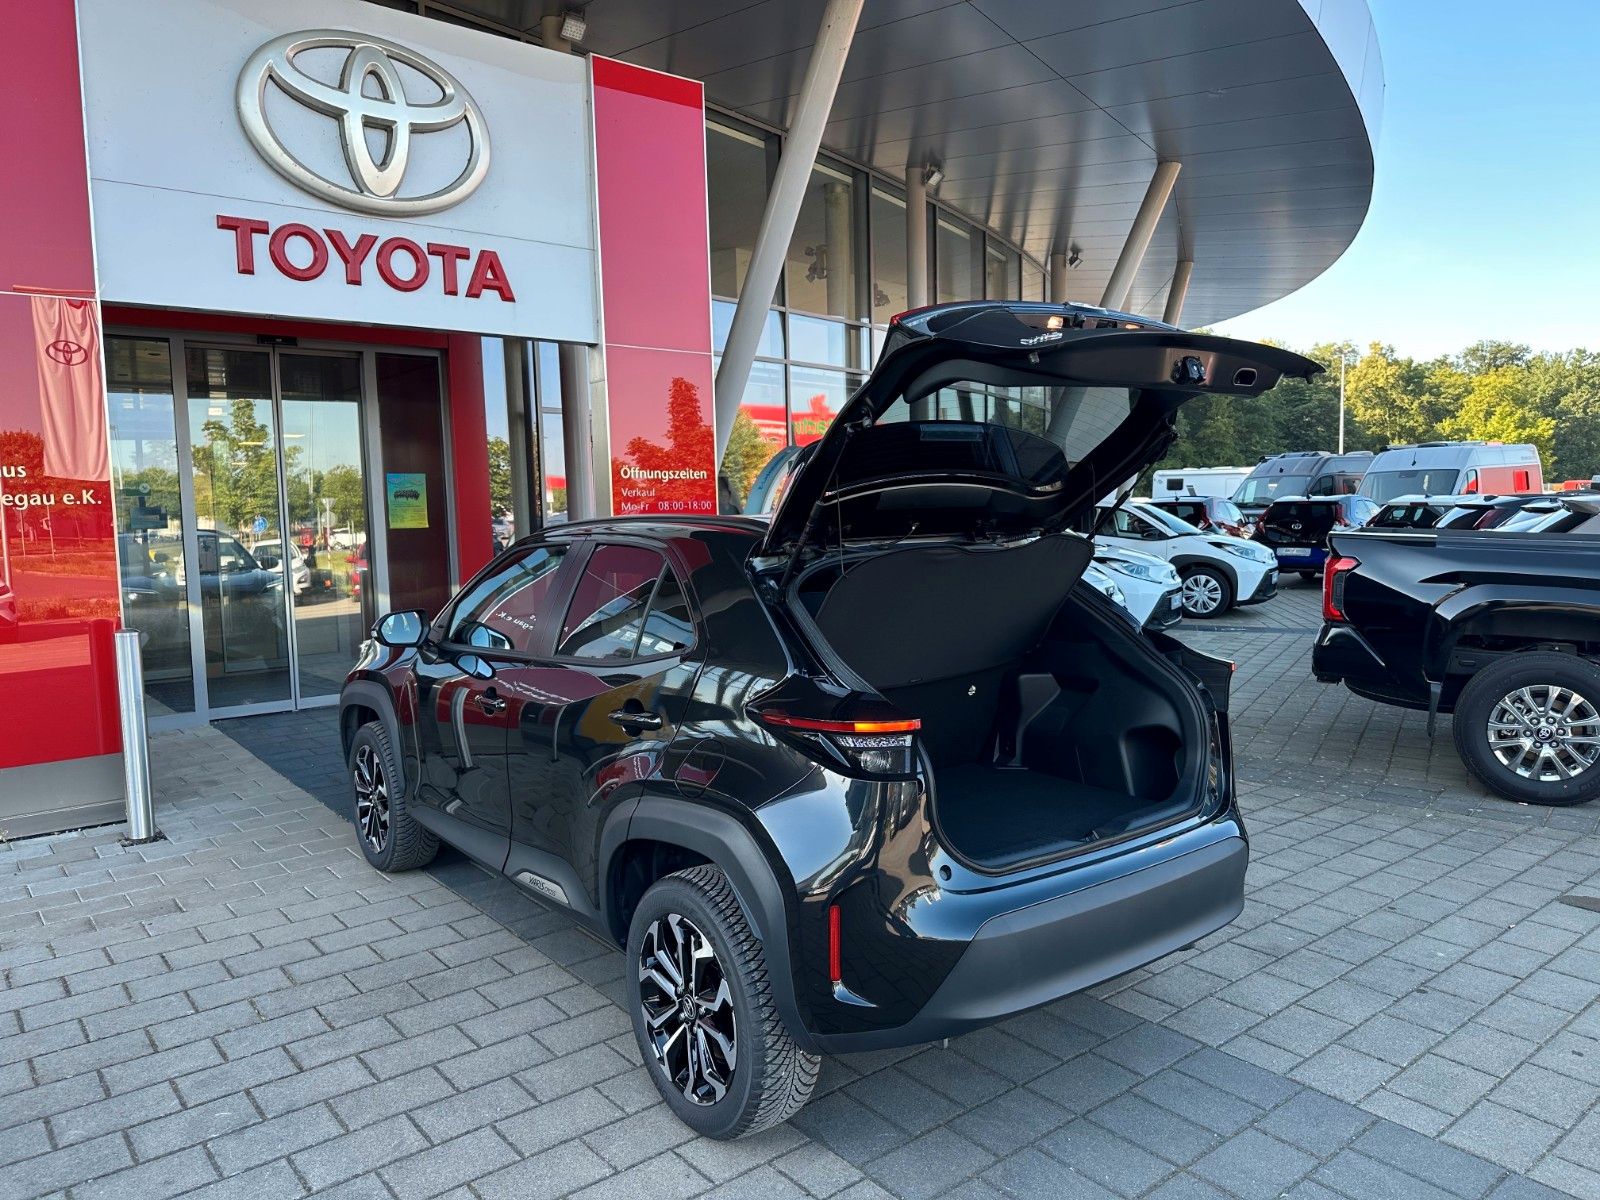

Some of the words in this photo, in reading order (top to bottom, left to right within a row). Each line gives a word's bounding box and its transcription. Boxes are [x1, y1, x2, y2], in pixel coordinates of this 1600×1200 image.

[216, 215, 515, 303] TOYOTA
[0, 465, 27, 478] us
[620, 465, 707, 482] Öffnungszeiten
[62, 489, 102, 505] e.K.
[621, 501, 649, 511] Mo-Fr
[658, 501, 712, 511] 08:00-18:00
